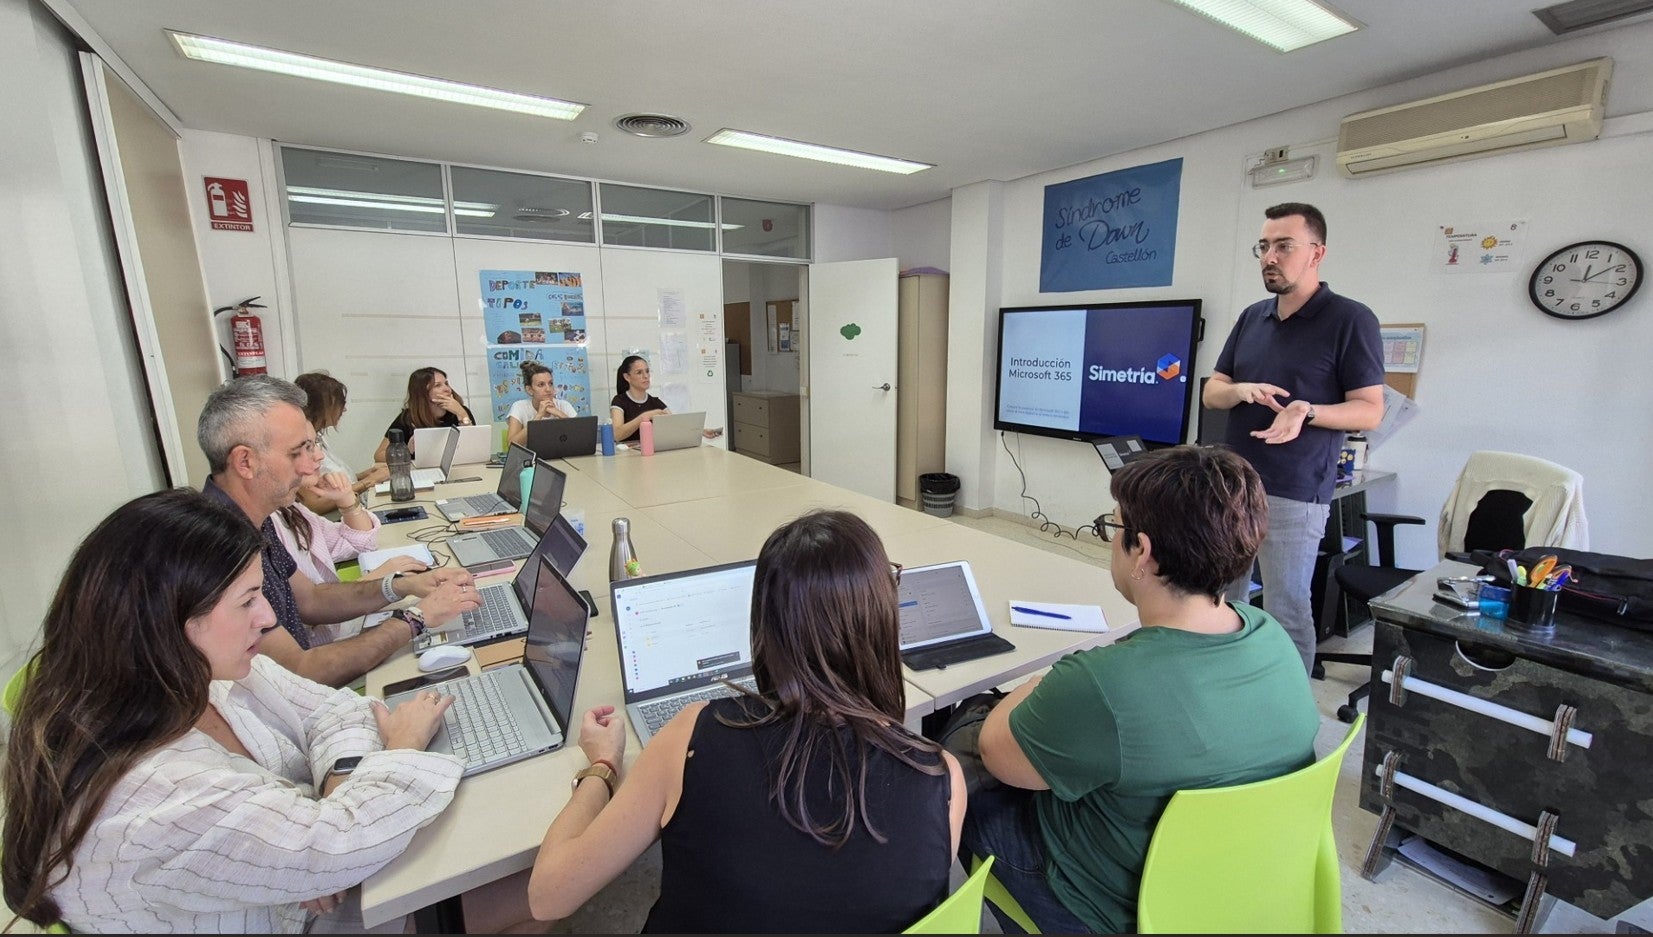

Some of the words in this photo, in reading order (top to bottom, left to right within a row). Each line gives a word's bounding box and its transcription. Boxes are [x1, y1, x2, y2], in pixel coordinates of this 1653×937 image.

[213, 222, 251, 231] EXTINTOR
[1055, 233, 1072, 250] de
[1079, 219, 1149, 251] Down
[1105, 248, 1157, 265] Castellón
[1570, 254, 1578, 263] 11
[1585, 250, 1600, 259] 12
[1607, 254, 1612, 263] 1
[1552, 264, 1566, 272] 10
[1615, 264, 1626, 273] 2
[1543, 276, 1553, 284] 9
[1616, 277, 1627, 286] 3
[489, 279, 535, 292] DEPORTE
[1544, 289, 1555, 297] 8
[1604, 291, 1616, 299] 4
[1555, 298, 1565, 306] 7
[1592, 299, 1601, 308] 5
[1570, 303, 1580, 311] 6
[493, 347, 544, 361] COMIDA
[1010, 357, 1071, 369] Introducción
[1008, 368, 1051, 380] Microsoft
[1054, 371, 1072, 381] 365
